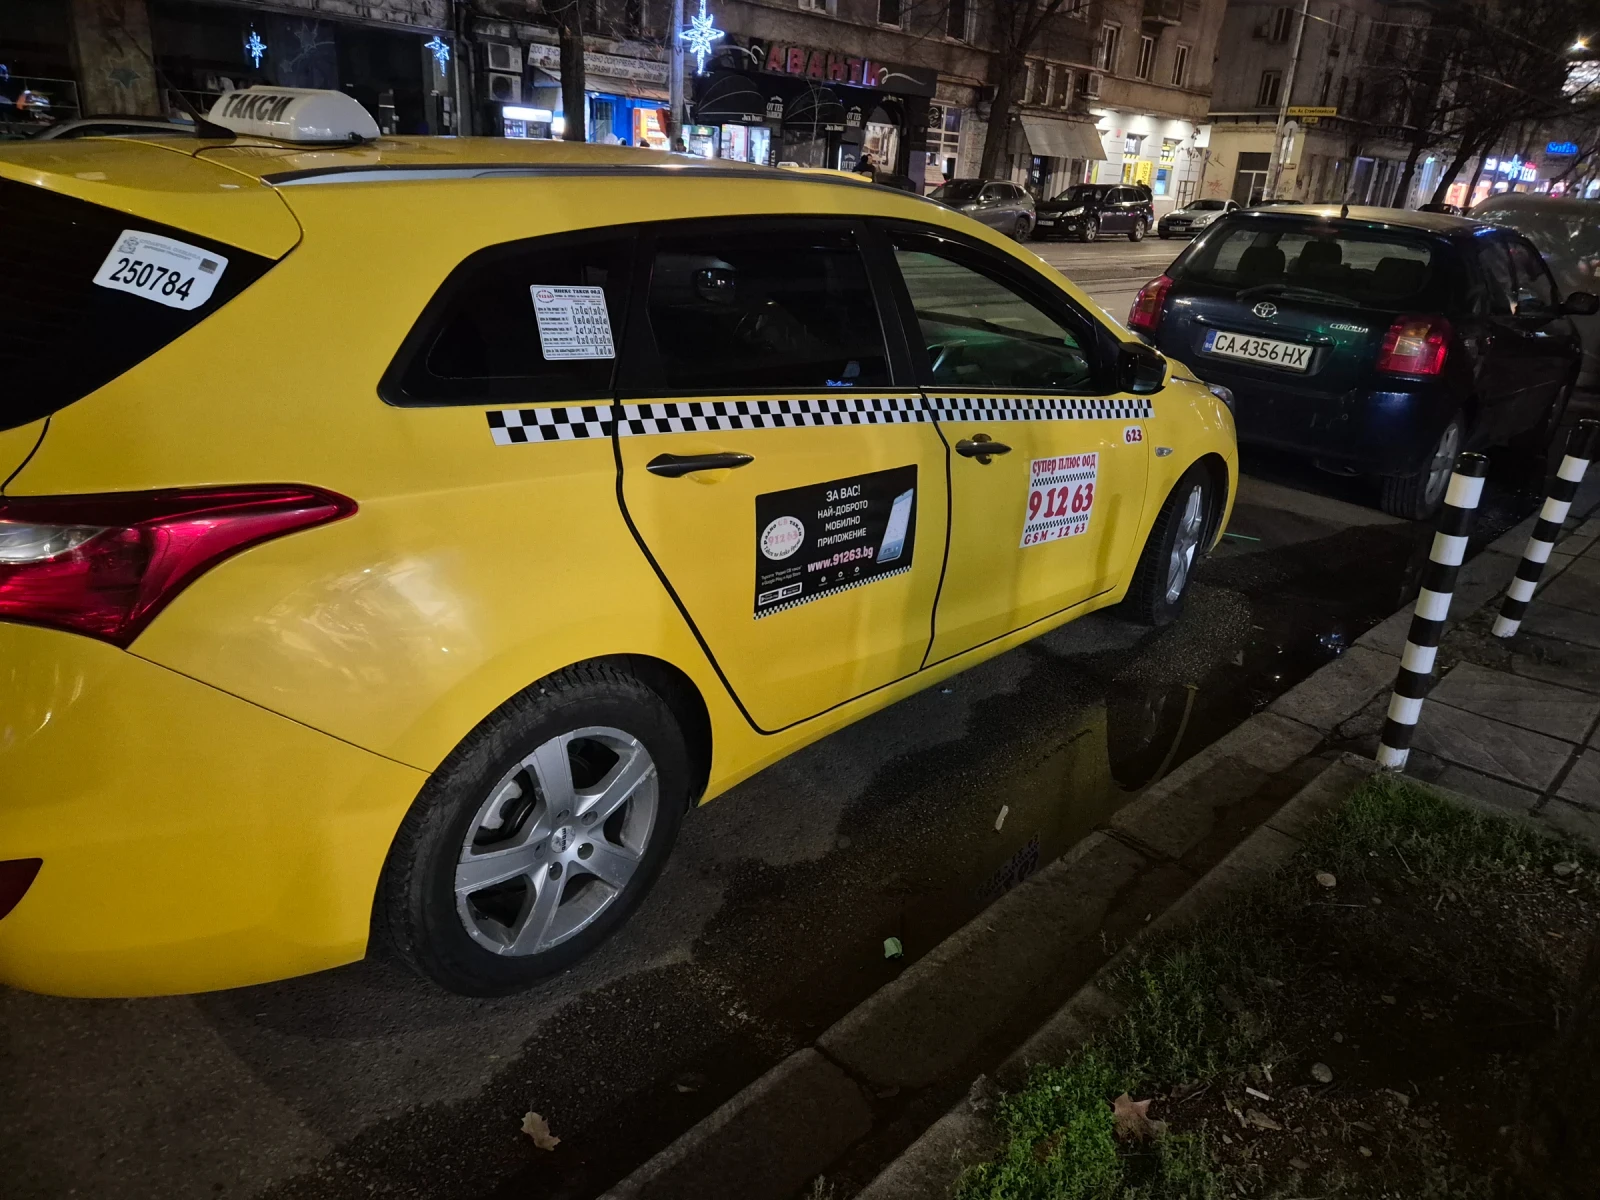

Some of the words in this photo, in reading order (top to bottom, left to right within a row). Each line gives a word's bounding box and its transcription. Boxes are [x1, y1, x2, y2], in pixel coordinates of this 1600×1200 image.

[766, 45, 881, 87] АВАНТИ
[222, 93, 295, 121] ТАКСИ
[109, 257, 195, 301] 250784
[1330, 322, 1369, 333] COROLLA
[1126, 429, 1142, 443] 623
[826, 490, 839, 502] ЗА
[840, 484, 861, 499] ВАС!
[817, 500, 868, 520] НАЙ-ДОБРОТО
[825, 515, 861, 532] МОБИЛНО
[817, 527, 867, 548] ПРИЛОЖЕНИЕ
[807, 545, 874, 572] www.91263.bg
